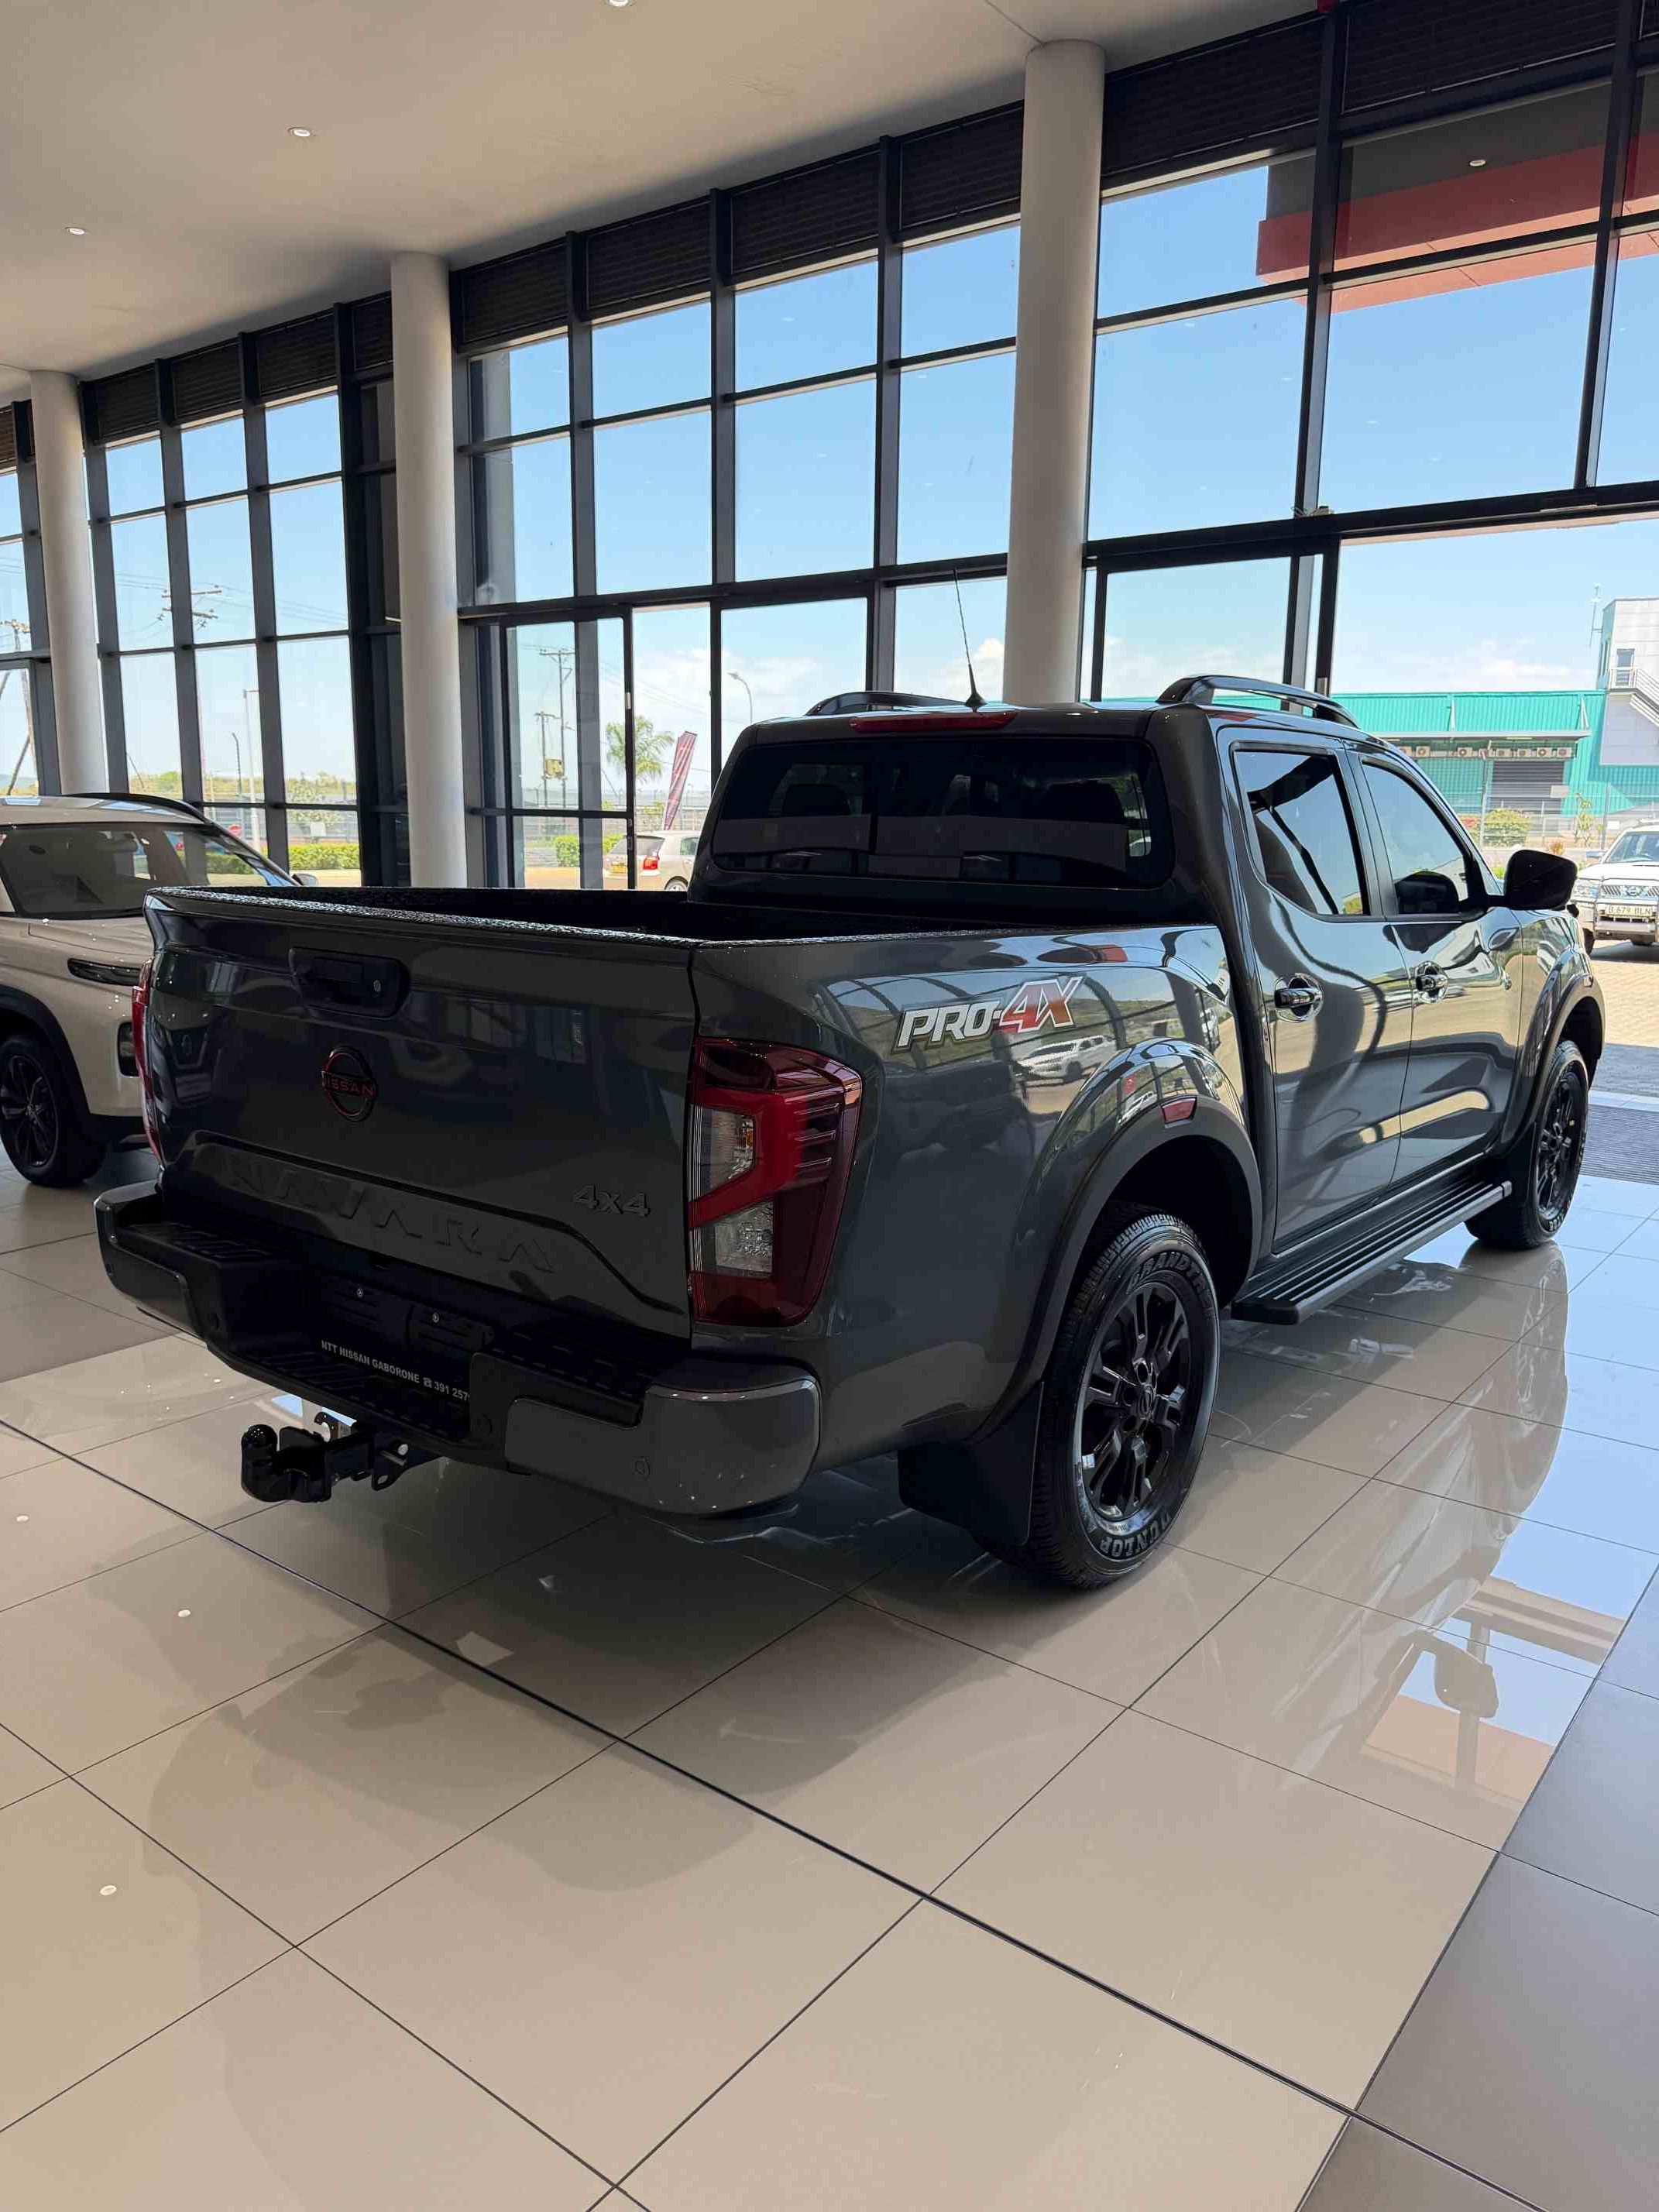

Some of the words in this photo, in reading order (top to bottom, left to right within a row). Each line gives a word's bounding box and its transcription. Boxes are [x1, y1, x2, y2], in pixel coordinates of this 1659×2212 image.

[894, 976, 1084, 1051] PRO-4X
[322, 1073, 377, 1097] NISSAN
[223, 1152, 555, 1275] NAVARA
[321, 1339, 338, 1354] NTT
[339, 1346, 370, 1365] NISSAN
[372, 1358, 421, 1384] GABORONE
[434, 1381, 450, 1394] 391
[1100, 1513, 1173, 1558] DUNLOP
